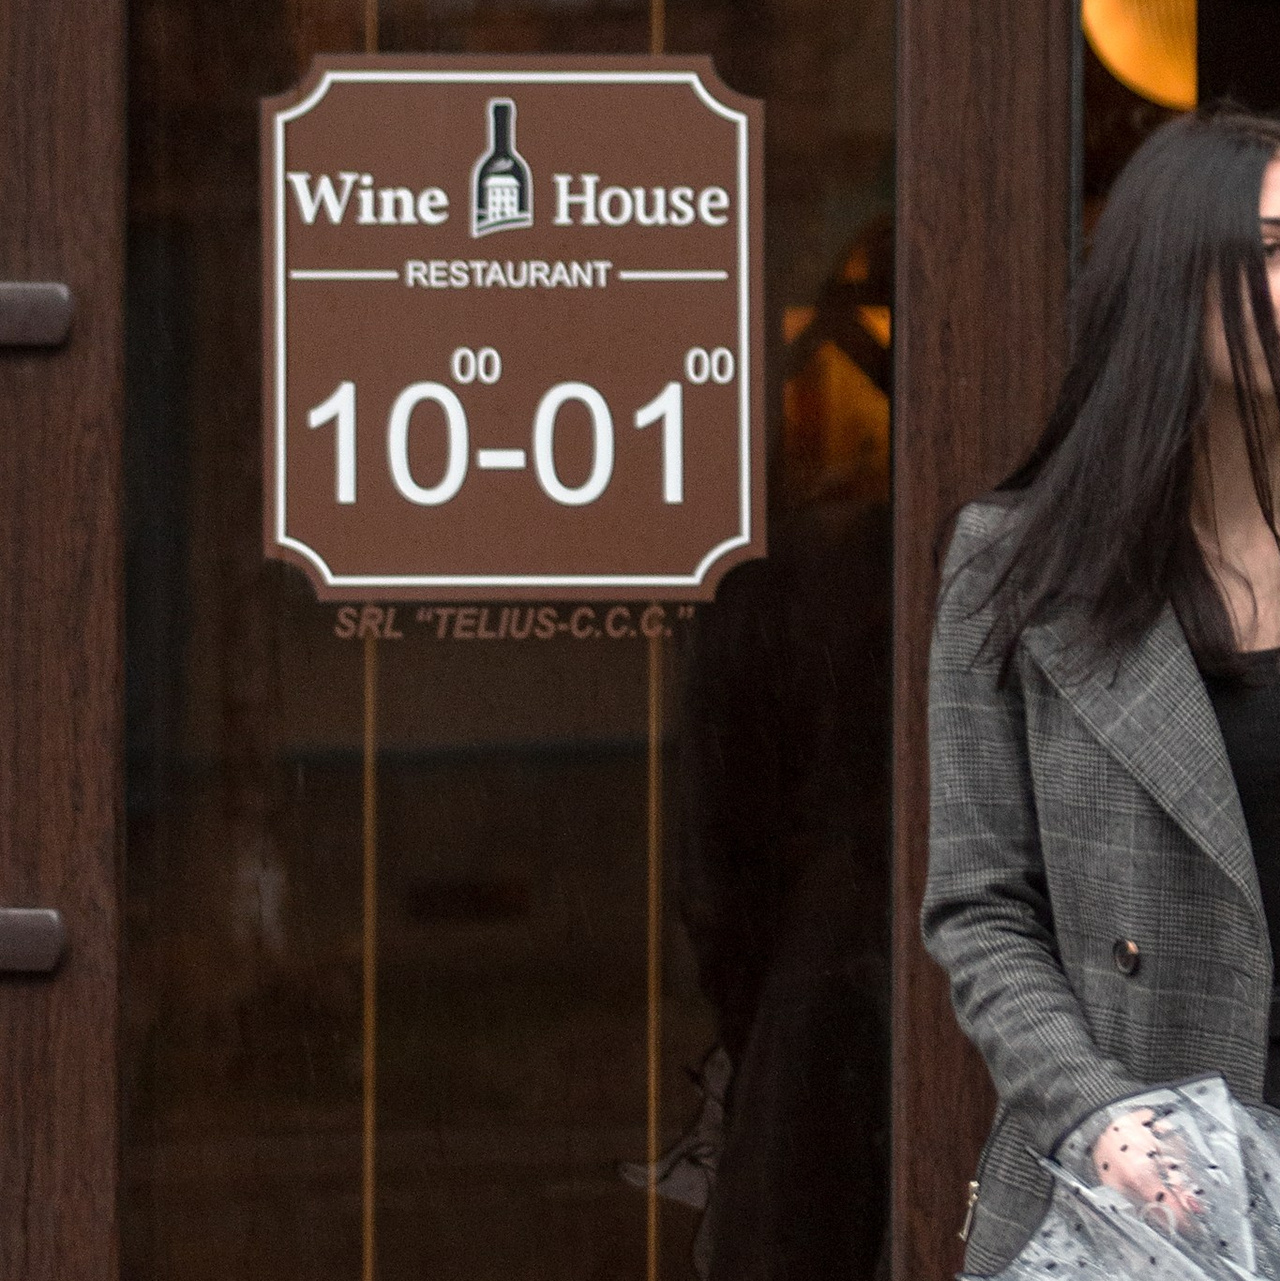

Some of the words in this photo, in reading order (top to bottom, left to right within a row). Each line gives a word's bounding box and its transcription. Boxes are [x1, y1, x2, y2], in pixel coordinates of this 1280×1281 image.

[287, 171, 450, 226] Wine
[553, 173, 730, 226] House
[405, 260, 612, 288] RESTAURANT
[334, 607, 404, 639] SRL
